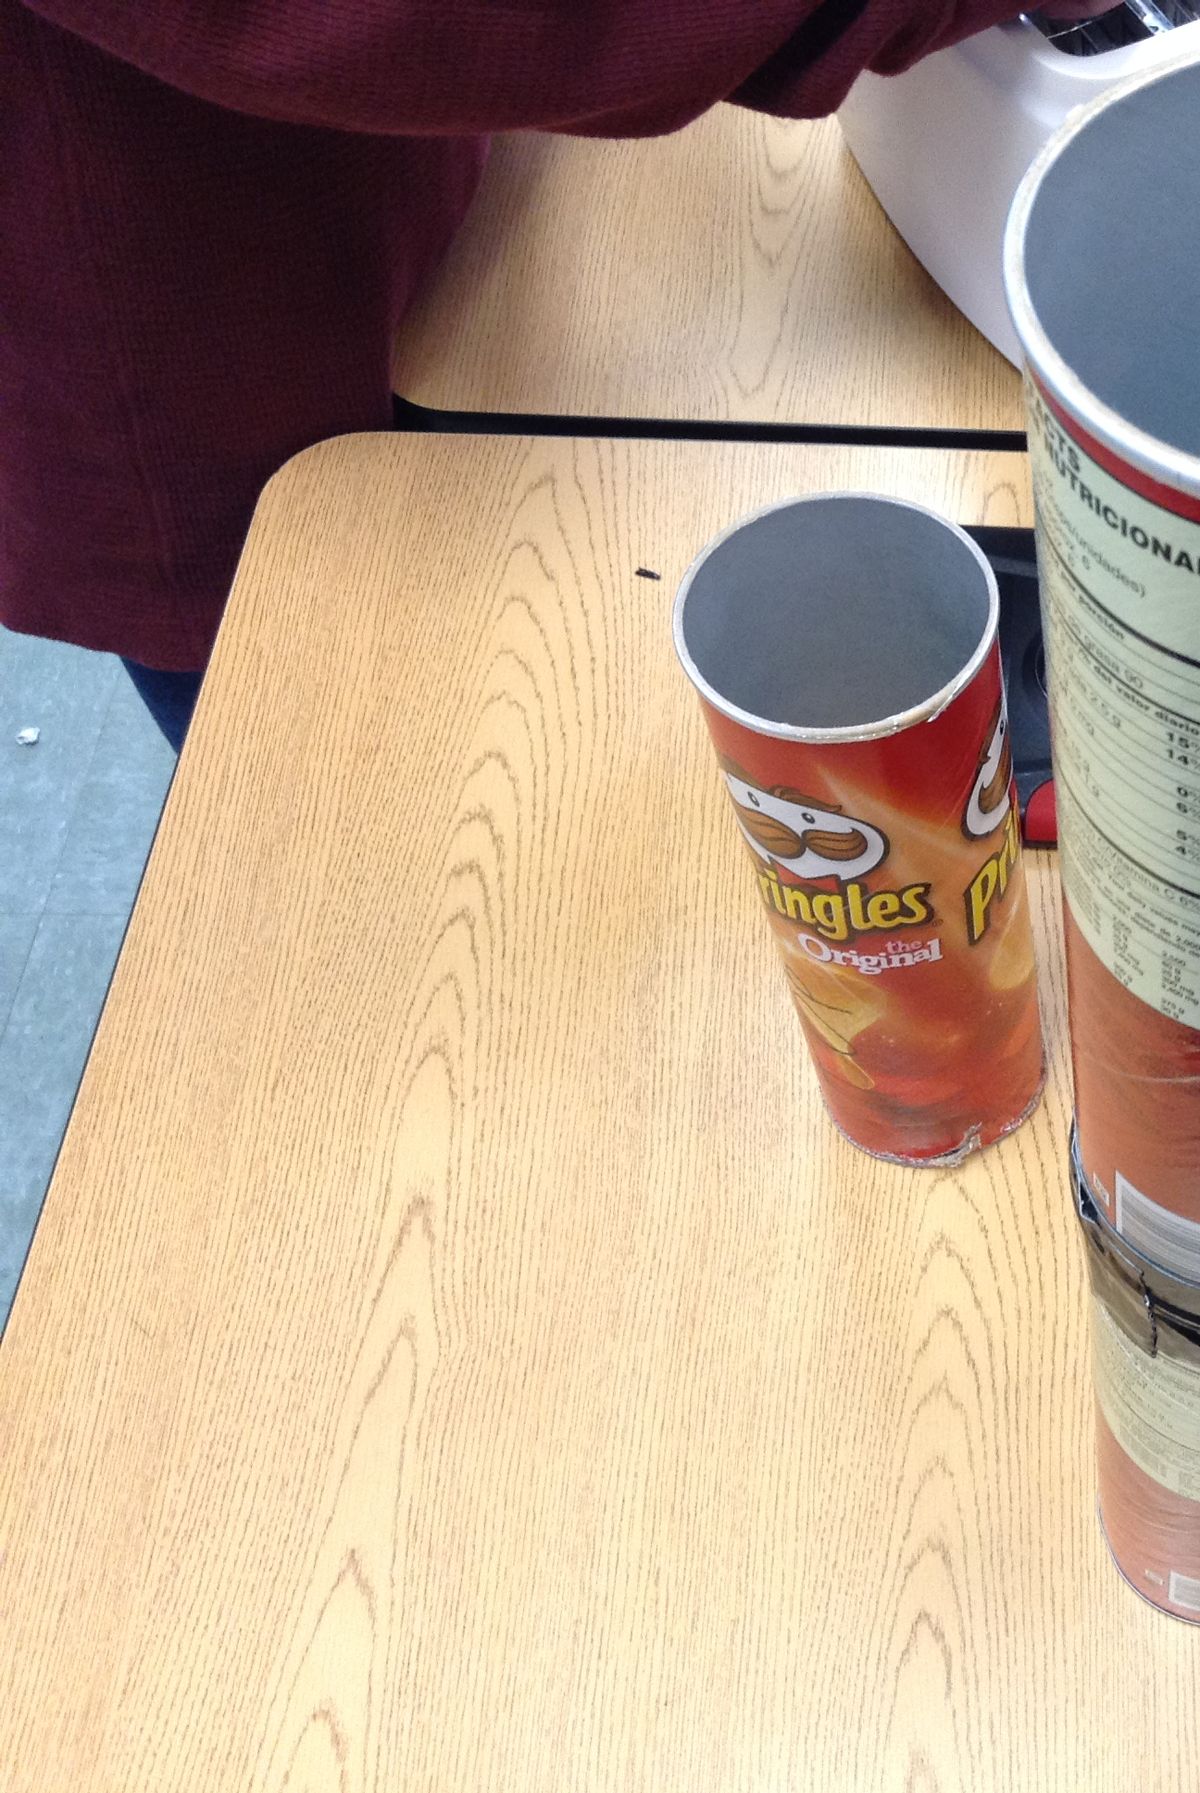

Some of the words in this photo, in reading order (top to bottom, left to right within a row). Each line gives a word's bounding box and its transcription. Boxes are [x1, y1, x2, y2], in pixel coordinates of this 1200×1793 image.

[756, 868, 932, 943] ringles
[798, 933, 943, 975] Original
[886, 940, 922, 952] the
